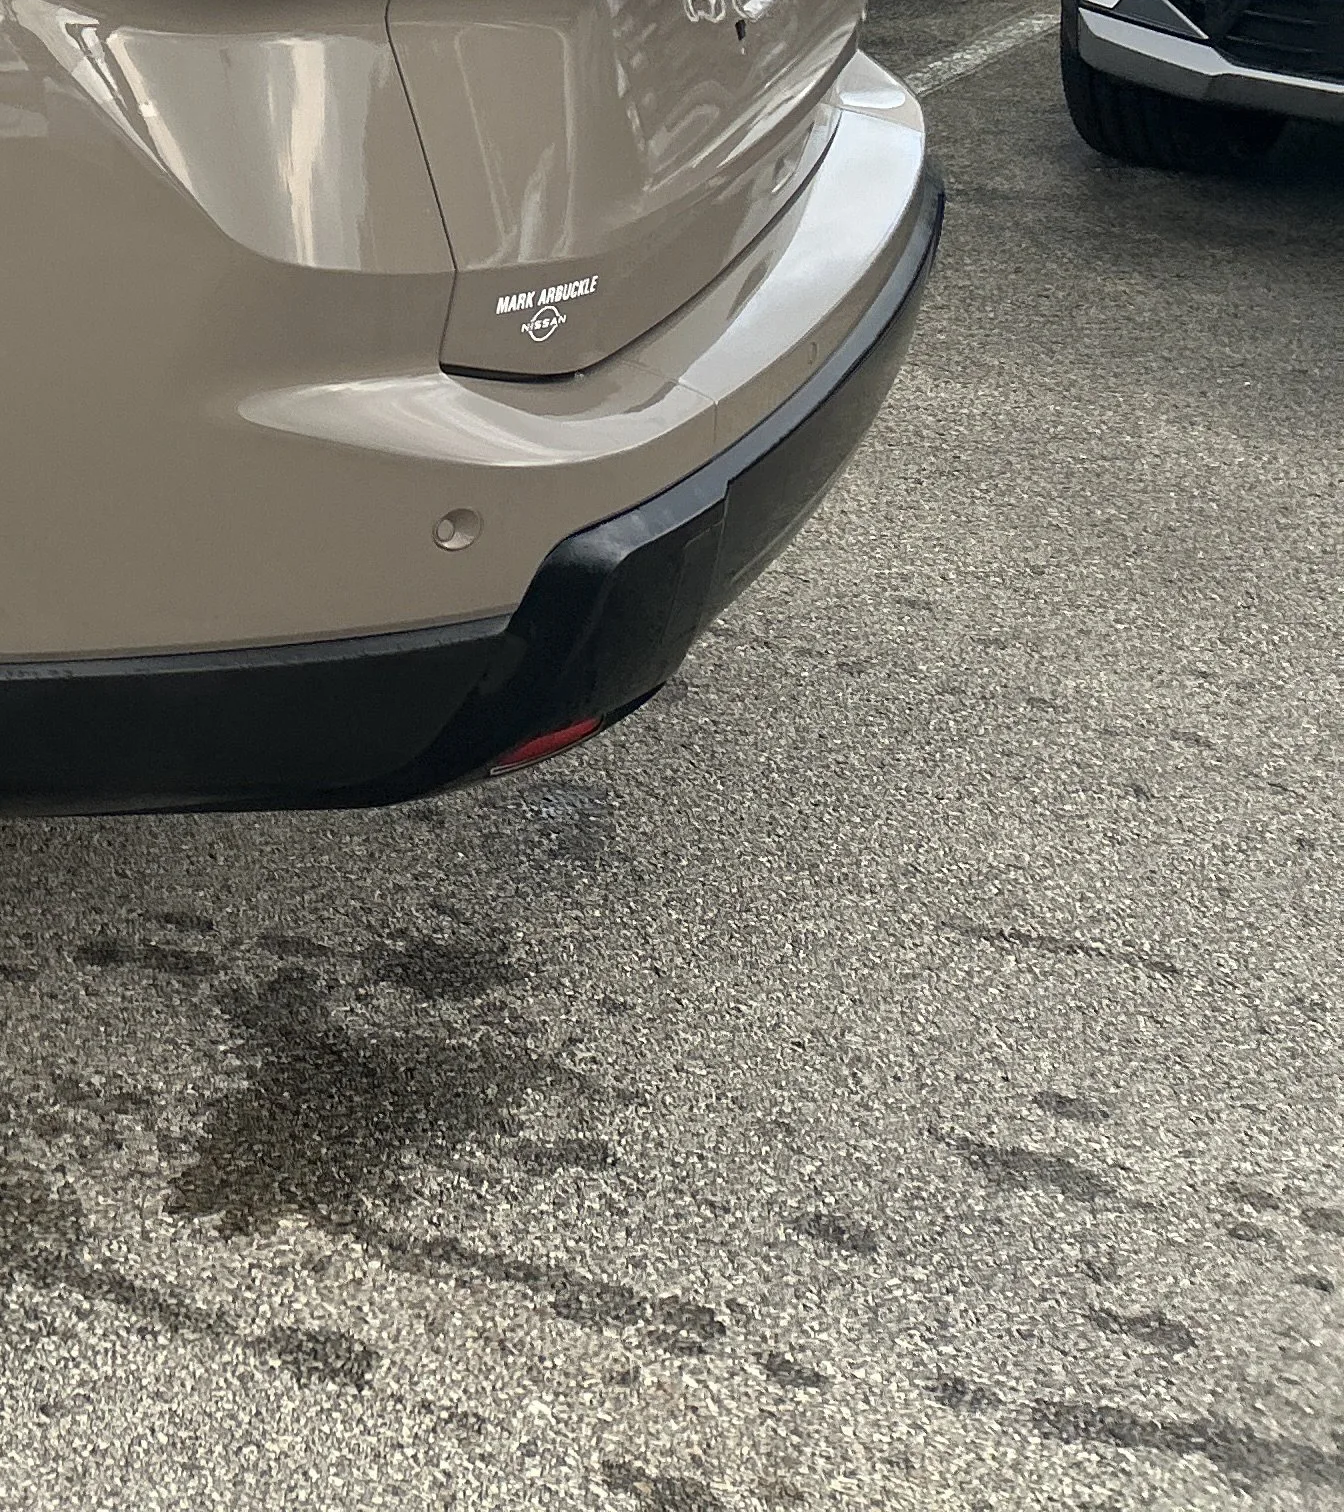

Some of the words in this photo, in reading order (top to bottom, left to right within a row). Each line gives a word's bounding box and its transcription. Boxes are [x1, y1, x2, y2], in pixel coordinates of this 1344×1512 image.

[496, 290, 535, 314] MARK
[537, 275, 599, 306] ARBUCKLE
[520, 314, 567, 333] NISSAN
